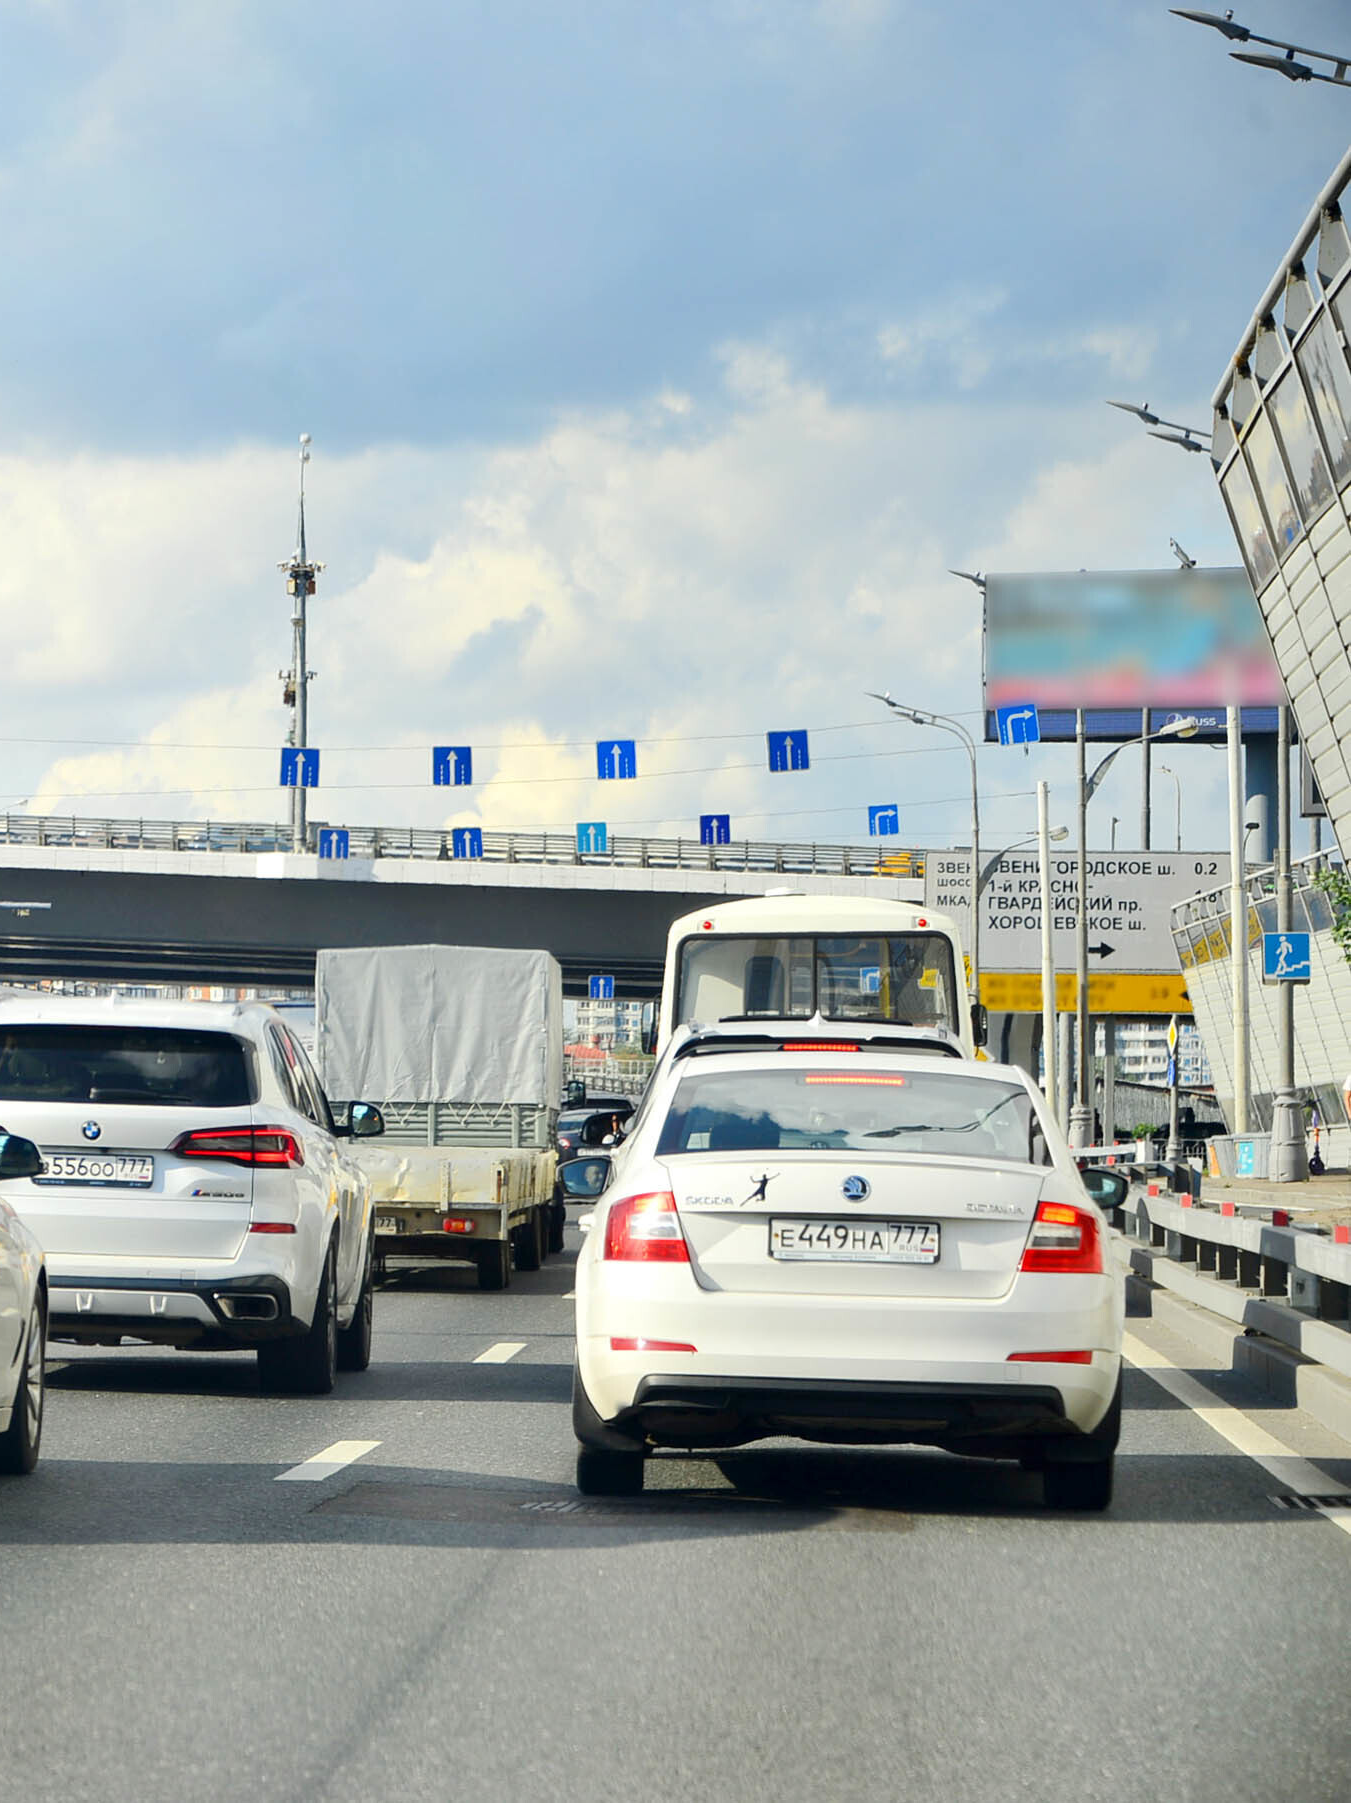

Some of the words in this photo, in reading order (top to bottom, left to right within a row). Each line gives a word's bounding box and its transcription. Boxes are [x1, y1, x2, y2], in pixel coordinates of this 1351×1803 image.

[1192, 716, 1217, 726] uss
[994, 860, 1152, 876] ВЕНОРОДСКОЕ
[1157, 865, 1176, 876] ш.
[1194, 862, 1218, 875] 0.2
[988, 880, 1012, 893] 1-й
[1019, 880, 1093, 894] КРСН-
[937, 895, 971, 909] МКА
[988, 894, 1113, 911] ГВАРДЙСИЙ
[1118, 900, 1142, 913] пр.
[988, 916, 1123, 931] ХОРОЕВКОЕ
[1128, 919, 1146, 931] ш.
[118, 1158, 147, 1173] 777
[780, 1223, 884, 1250] Е449НА
[890, 1224, 930, 1245] 777
